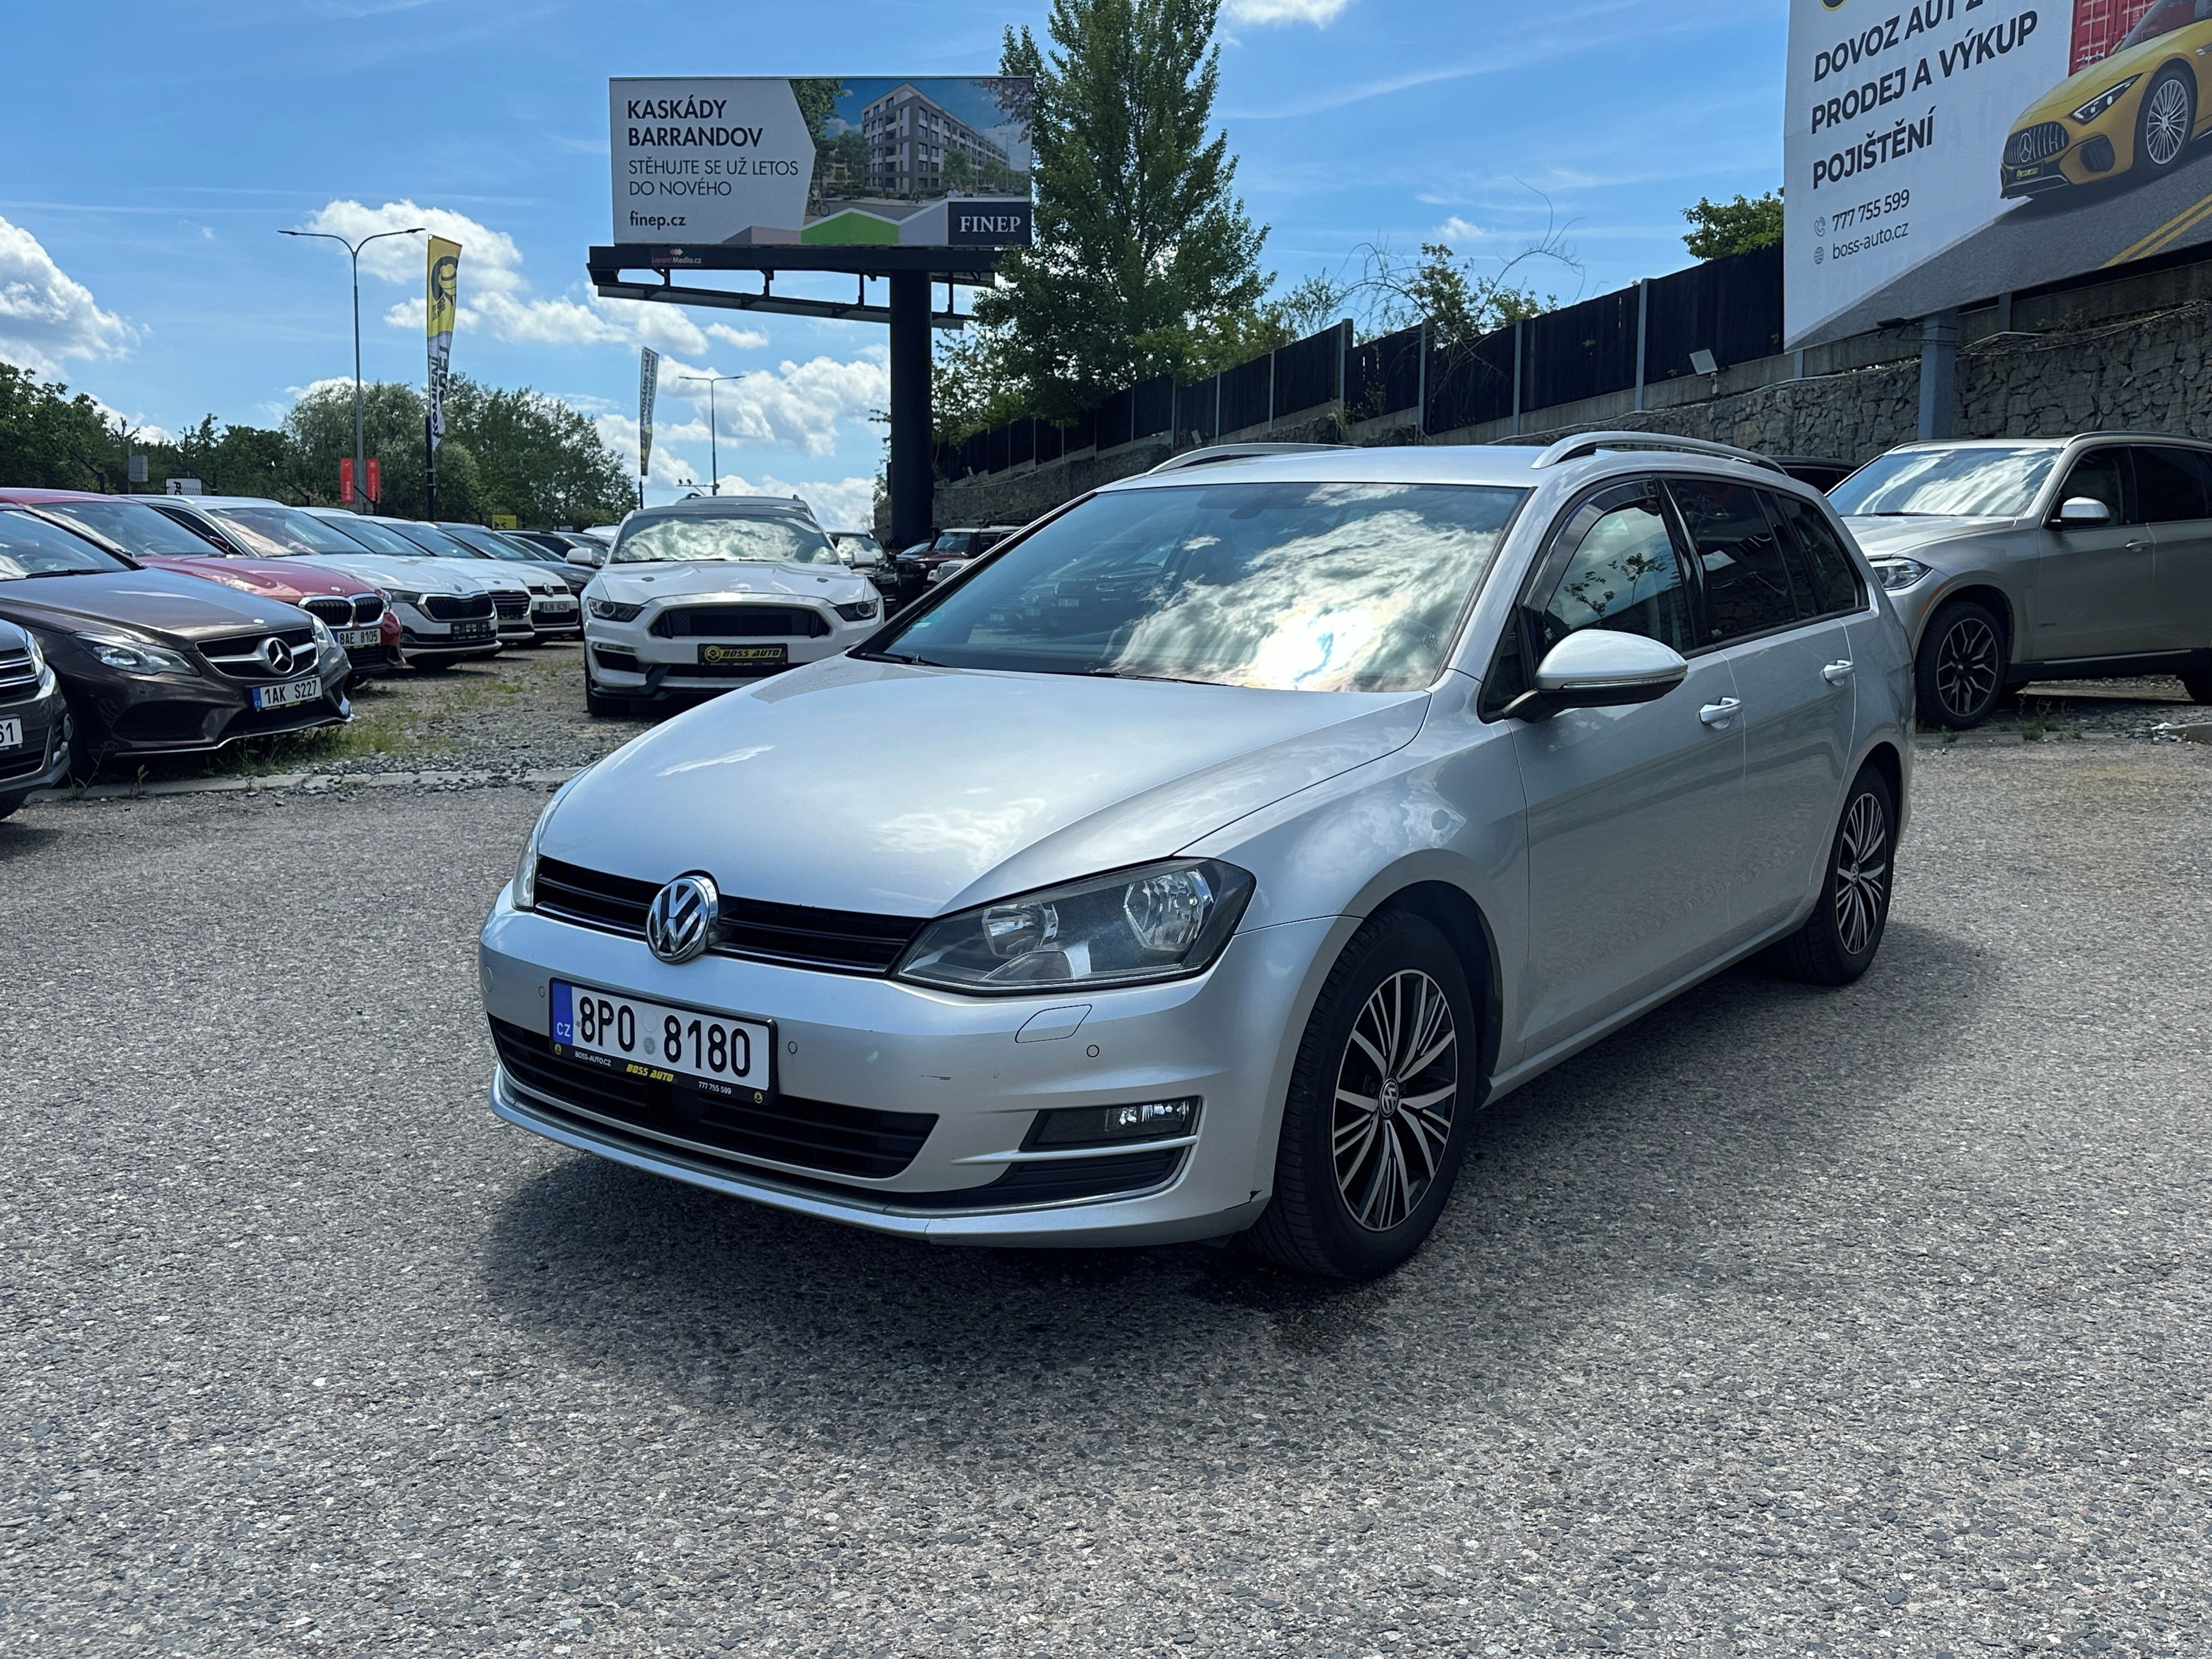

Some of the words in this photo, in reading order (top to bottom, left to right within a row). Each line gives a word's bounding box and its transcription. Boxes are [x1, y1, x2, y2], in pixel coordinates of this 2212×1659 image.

[1814, 15, 1900, 82] DOVOZ
[1812, 66, 1906, 134] PRODEJ
[1912, 58, 1932, 92] A
[1939, 10, 2038, 78] VÝKUP
[628, 94, 727, 119] KASKÁDY
[628, 127, 763, 148] BARRANDOV
[1814, 105, 1937, 189] POJIŠTĚNÍ
[629, 156, 699, 174] STĚHUJTE
[704, 160, 721, 174] SE
[726, 157, 748, 175] UŽ
[752, 161, 798, 176] LETOS
[629, 181, 654, 196] DO
[660, 177, 732, 196] NOVÉHO
[630, 211, 686, 230] finep.cz
[1832, 208, 1855, 232] 777
[1858, 199, 1881, 223] 755
[1884, 189, 1909, 213] 599
[959, 216, 1021, 233] FINEP
[1833, 223, 1909, 259] boss-auto.cz
[340, 632, 355, 645] 8AE
[360, 630, 378, 644] 8105
[722, 650, 749, 658] BOSS
[752, 649, 781, 657] AUTO
[264, 686, 286, 704] 1AK
[295, 680, 317, 699] S227
[557, 1022, 571, 1037] CZ
[664, 1015, 751, 1077] 8180
[574, 1051, 612, 1066] BOSS-AUTO.CZ
[626, 1063, 648, 1076] BOSS
[649, 1070, 674, 1082] AUTO
[698, 1081, 708, 1090] 777
[709, 1083, 720, 1092] 755
[720, 1086, 732, 1095] 599
